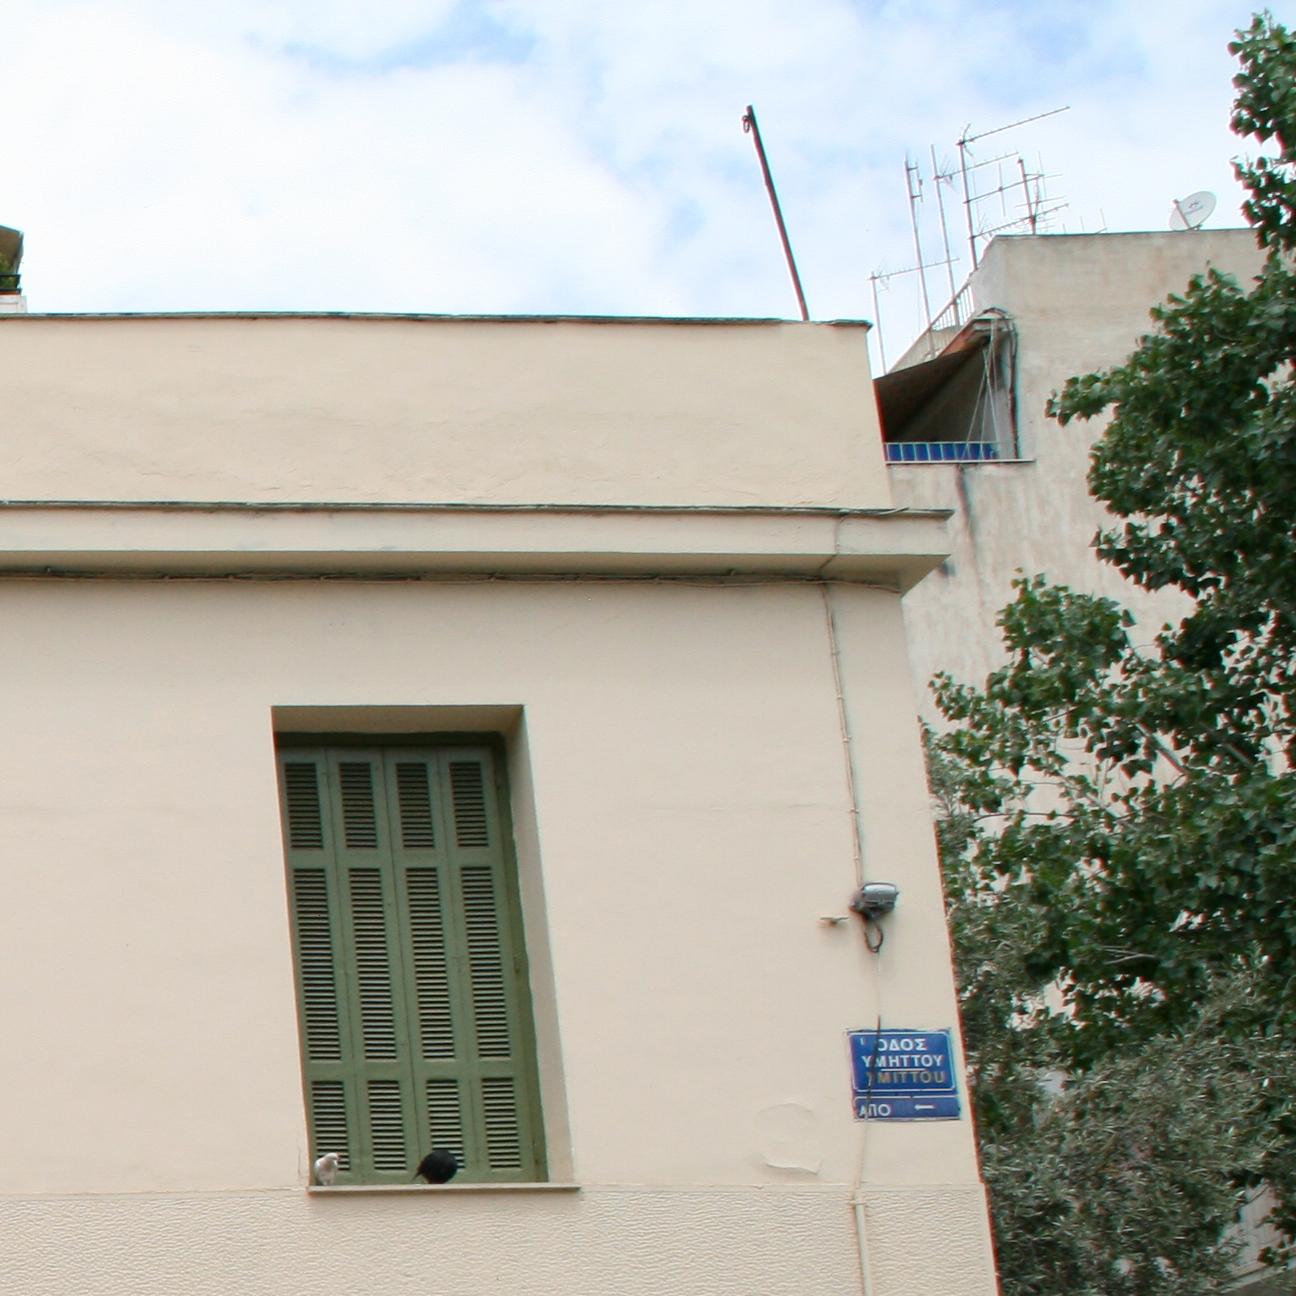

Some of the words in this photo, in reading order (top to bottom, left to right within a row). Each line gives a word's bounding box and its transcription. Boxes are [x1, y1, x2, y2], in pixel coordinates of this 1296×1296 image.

[876, 1038, 927, 1051] ΟΔΟΣ
[861, 1054, 943, 1067] ΥΜΗΤΤΟΥ
[859, 1104, 891, 1117] ΑΠΟ
